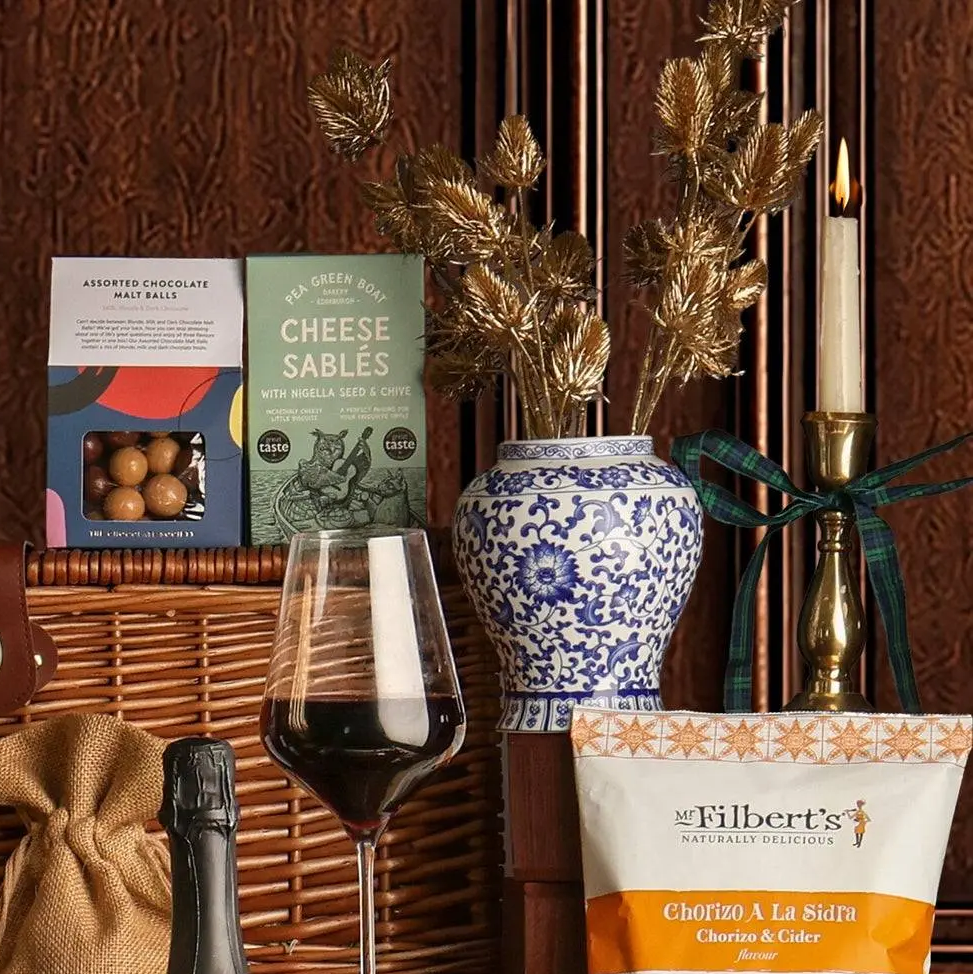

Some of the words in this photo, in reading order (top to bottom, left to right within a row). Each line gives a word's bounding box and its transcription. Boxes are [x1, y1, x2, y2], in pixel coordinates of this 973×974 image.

[83, 280, 139, 288] ASSORTED
[143, 280, 209, 288] CHOCOLATE
[284, 284, 308, 305] PEA
[311, 272, 353, 287] GREEN
[357, 278, 388, 304] BOAT
[114, 291, 142, 299] MALT
[145, 291, 178, 299] BALLS
[280, 316, 391, 343] CHEESE
[282, 344, 389, 378] SABLÉS
[260, 388, 287, 399] WITH
[291, 387, 335, 398] NIGELLA
[339, 386, 366, 397] SEED
[369, 387, 377, 396] &
[380, 385, 412, 396] CHIVE
[259, 441, 290, 453] taste
[385, 440, 416, 450] taste
[696, 804, 843, 831] Filbert's
[682, 834, 758, 845] NATURALLY
[762, 835, 834, 846] DELICIOUS
[663, 902, 745, 922] Chorizo
[747, 903, 765, 920] A
[771, 903, 796, 921] La
[802, 902, 857, 923] Sidra
[696, 928, 757, 943] Chorizo
[760, 929, 775, 943] &
[778, 928, 821, 944] Cider
[733, 948, 778, 963] flavour
